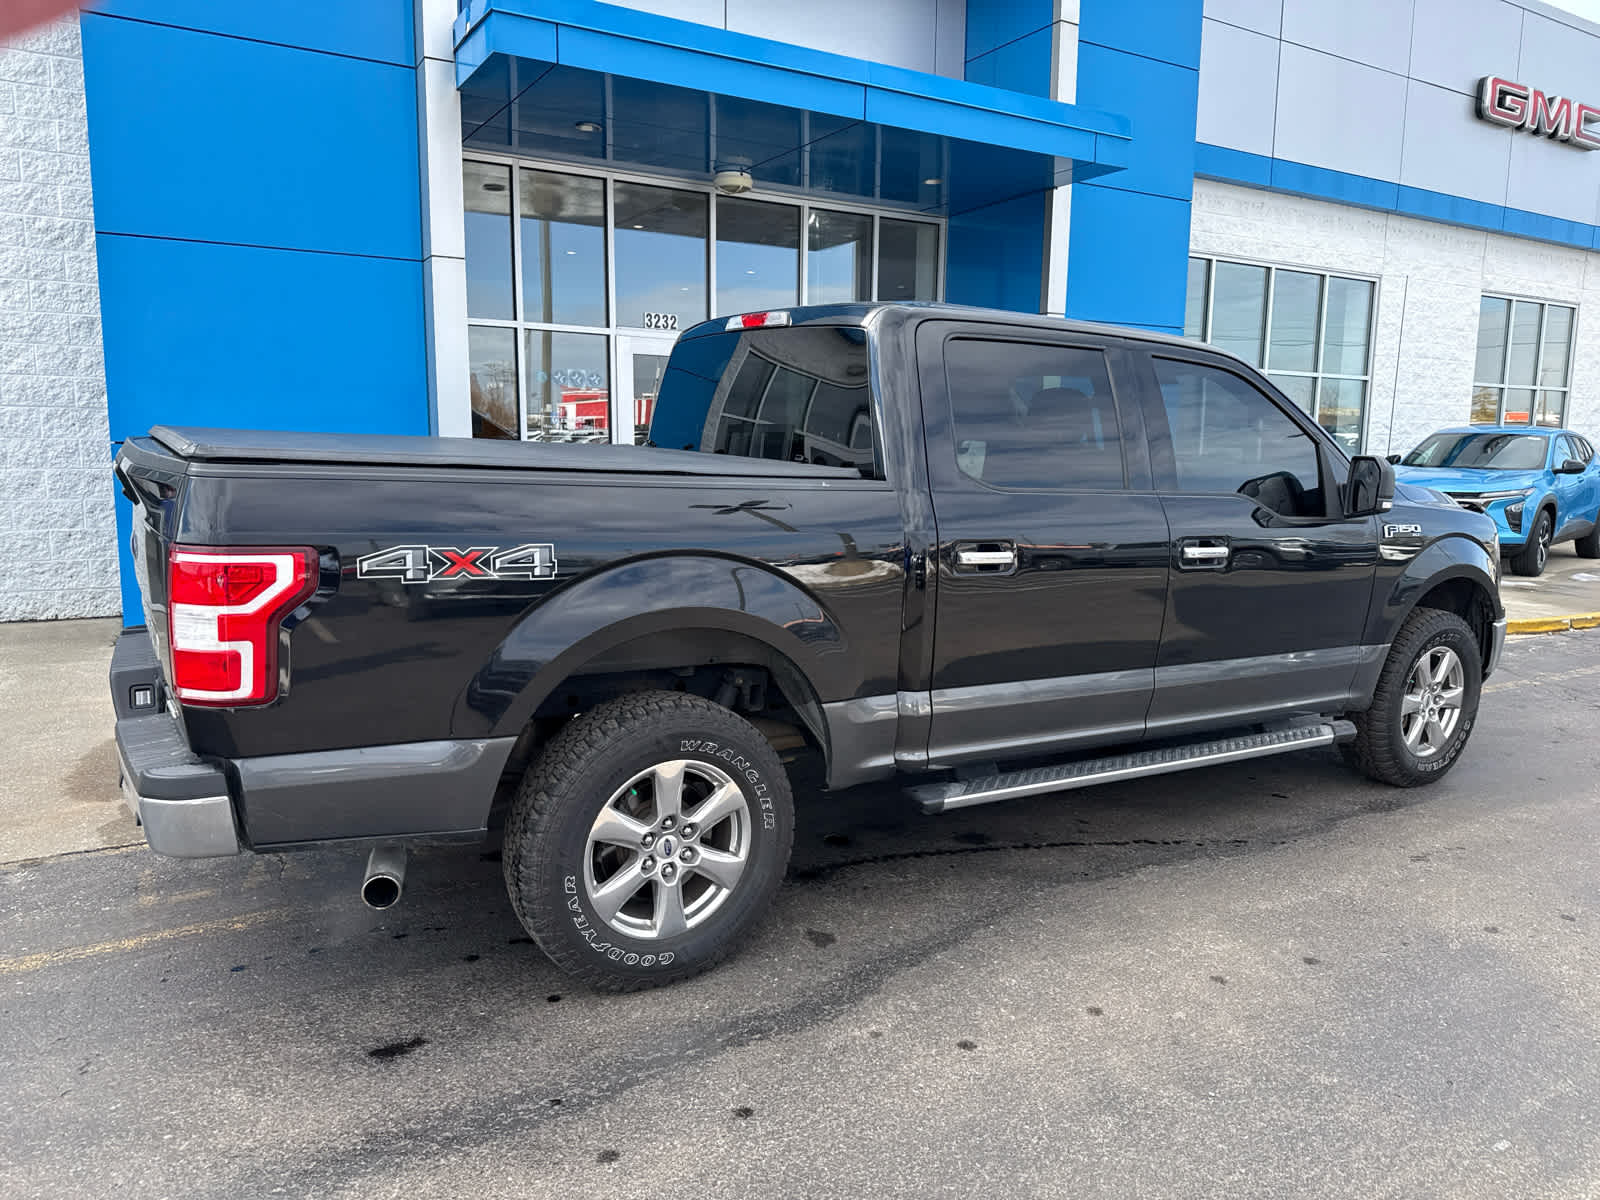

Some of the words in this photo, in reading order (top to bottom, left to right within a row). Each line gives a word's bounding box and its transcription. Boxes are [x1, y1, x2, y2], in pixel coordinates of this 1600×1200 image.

[1476, 76, 1600, 150] GMC
[646, 313, 677, 330] 3232
[681, 740, 775, 830] WRANGLER
[565, 875, 675, 967] GOODYEAR
